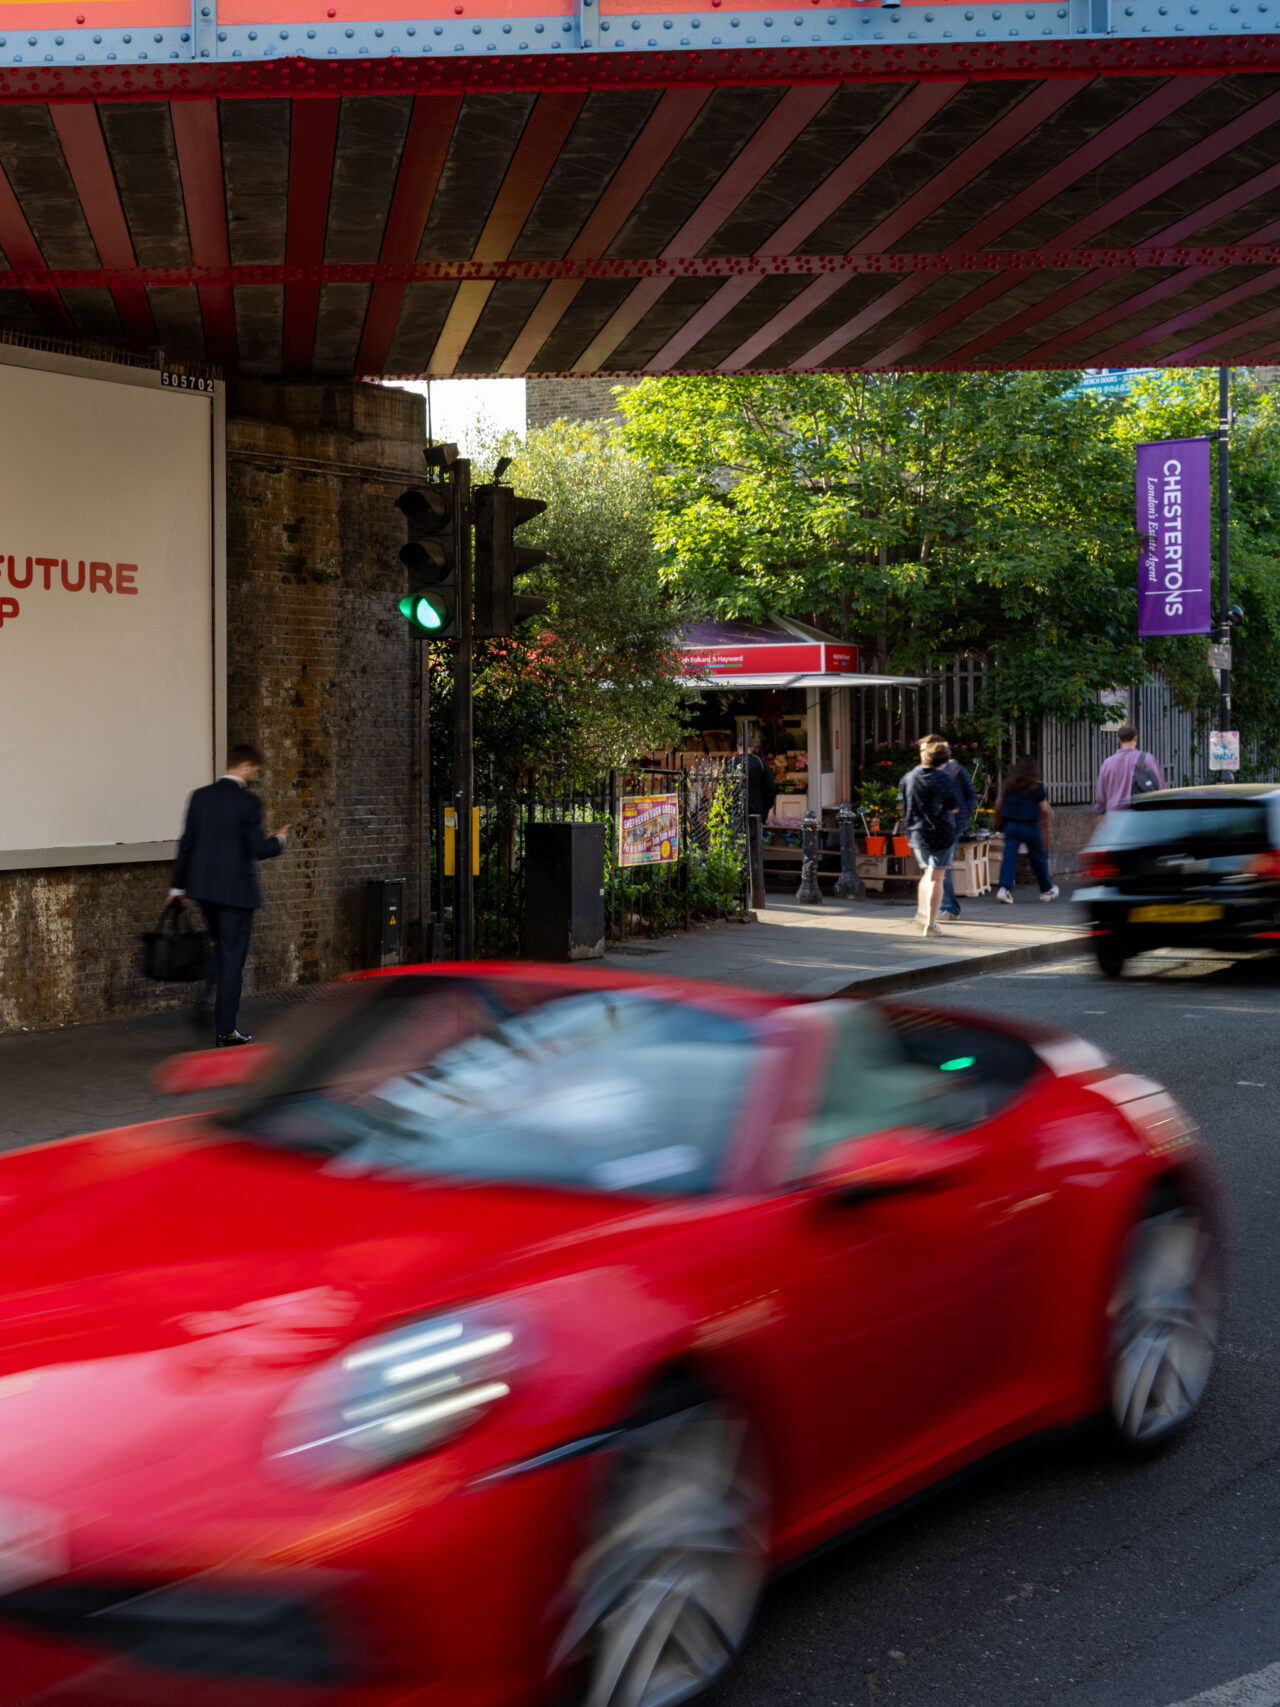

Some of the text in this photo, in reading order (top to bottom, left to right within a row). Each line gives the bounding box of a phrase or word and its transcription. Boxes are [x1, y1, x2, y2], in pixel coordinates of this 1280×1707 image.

[163, 372, 213, 392] 505702
[1145, 477, 1158, 582] London's Estate Agent
[1163, 460, 1183, 616] CHESTERTONS
[717, 655, 743, 663] Hayward
[662, 804, 676, 815] GREEN
